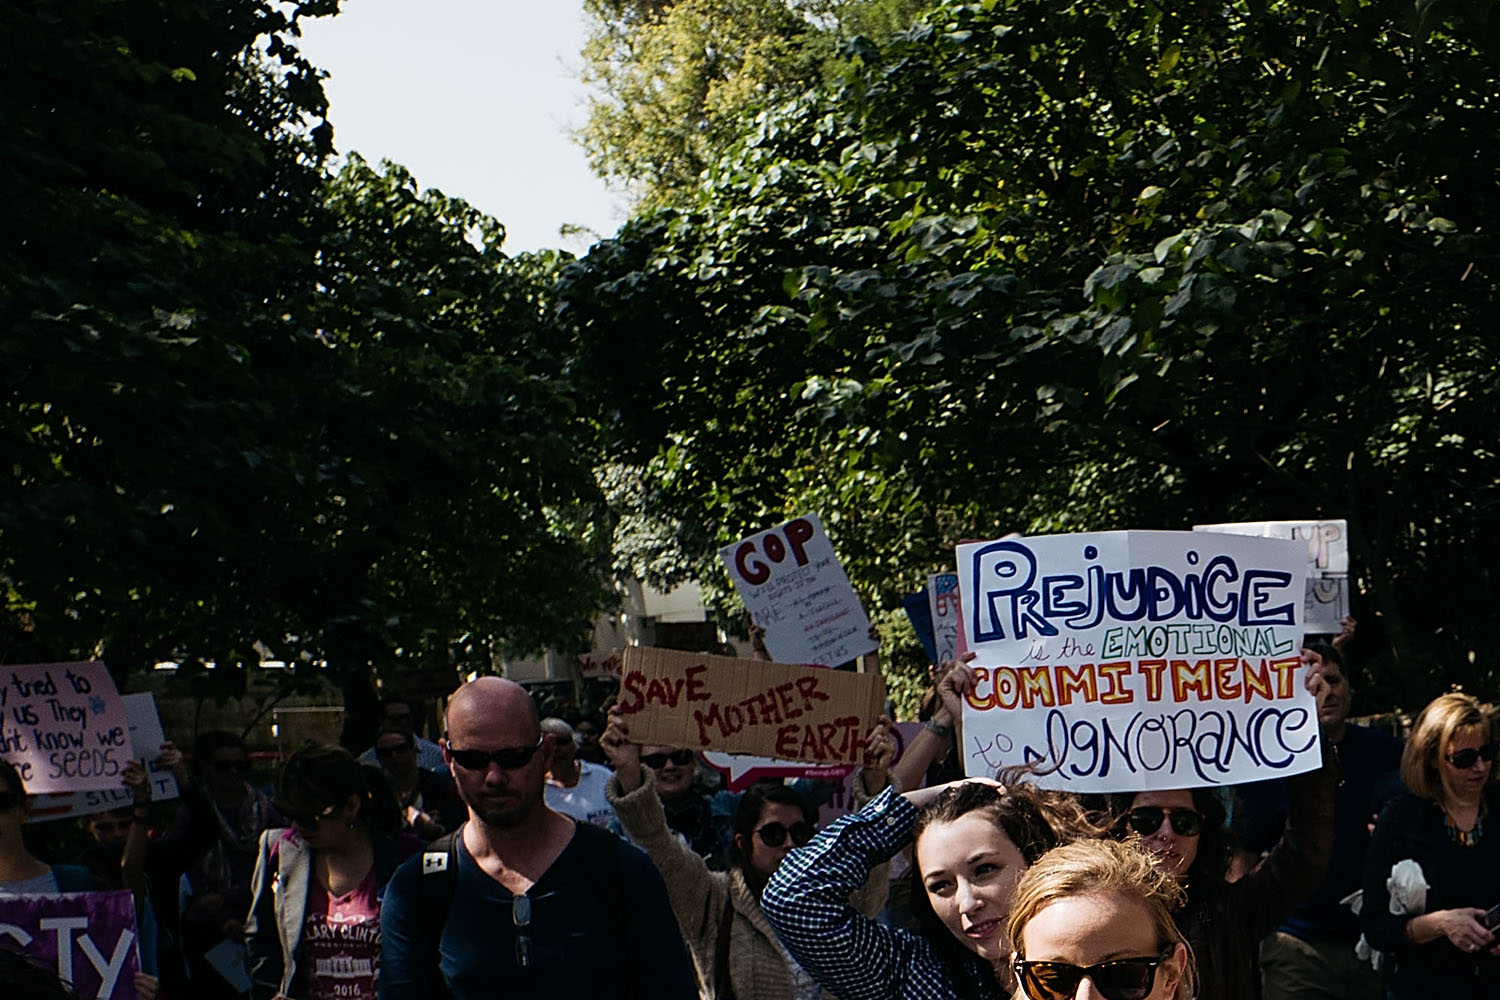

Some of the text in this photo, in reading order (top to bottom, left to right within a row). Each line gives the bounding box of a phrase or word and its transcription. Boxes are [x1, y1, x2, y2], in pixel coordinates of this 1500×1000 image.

[735, 518, 814, 586] GOP
[1019, 622, 1294, 664] is the EMOTIONAL
[11, 672, 58, 698] tried
[66, 669, 92, 694] to
[619, 664, 713, 715] SAVE
[964, 656, 1302, 711] COMMITMENT
[13, 704, 40, 726] us
[46, 698, 86, 730] They
[692, 675, 830, 747] MOTHER
[33, 728, 84, 751] know
[97, 726, 126, 747] we
[774, 715, 875, 765] EARTH
[971, 733, 1014, 768] to
[333, 983, 361, 997] 2016
